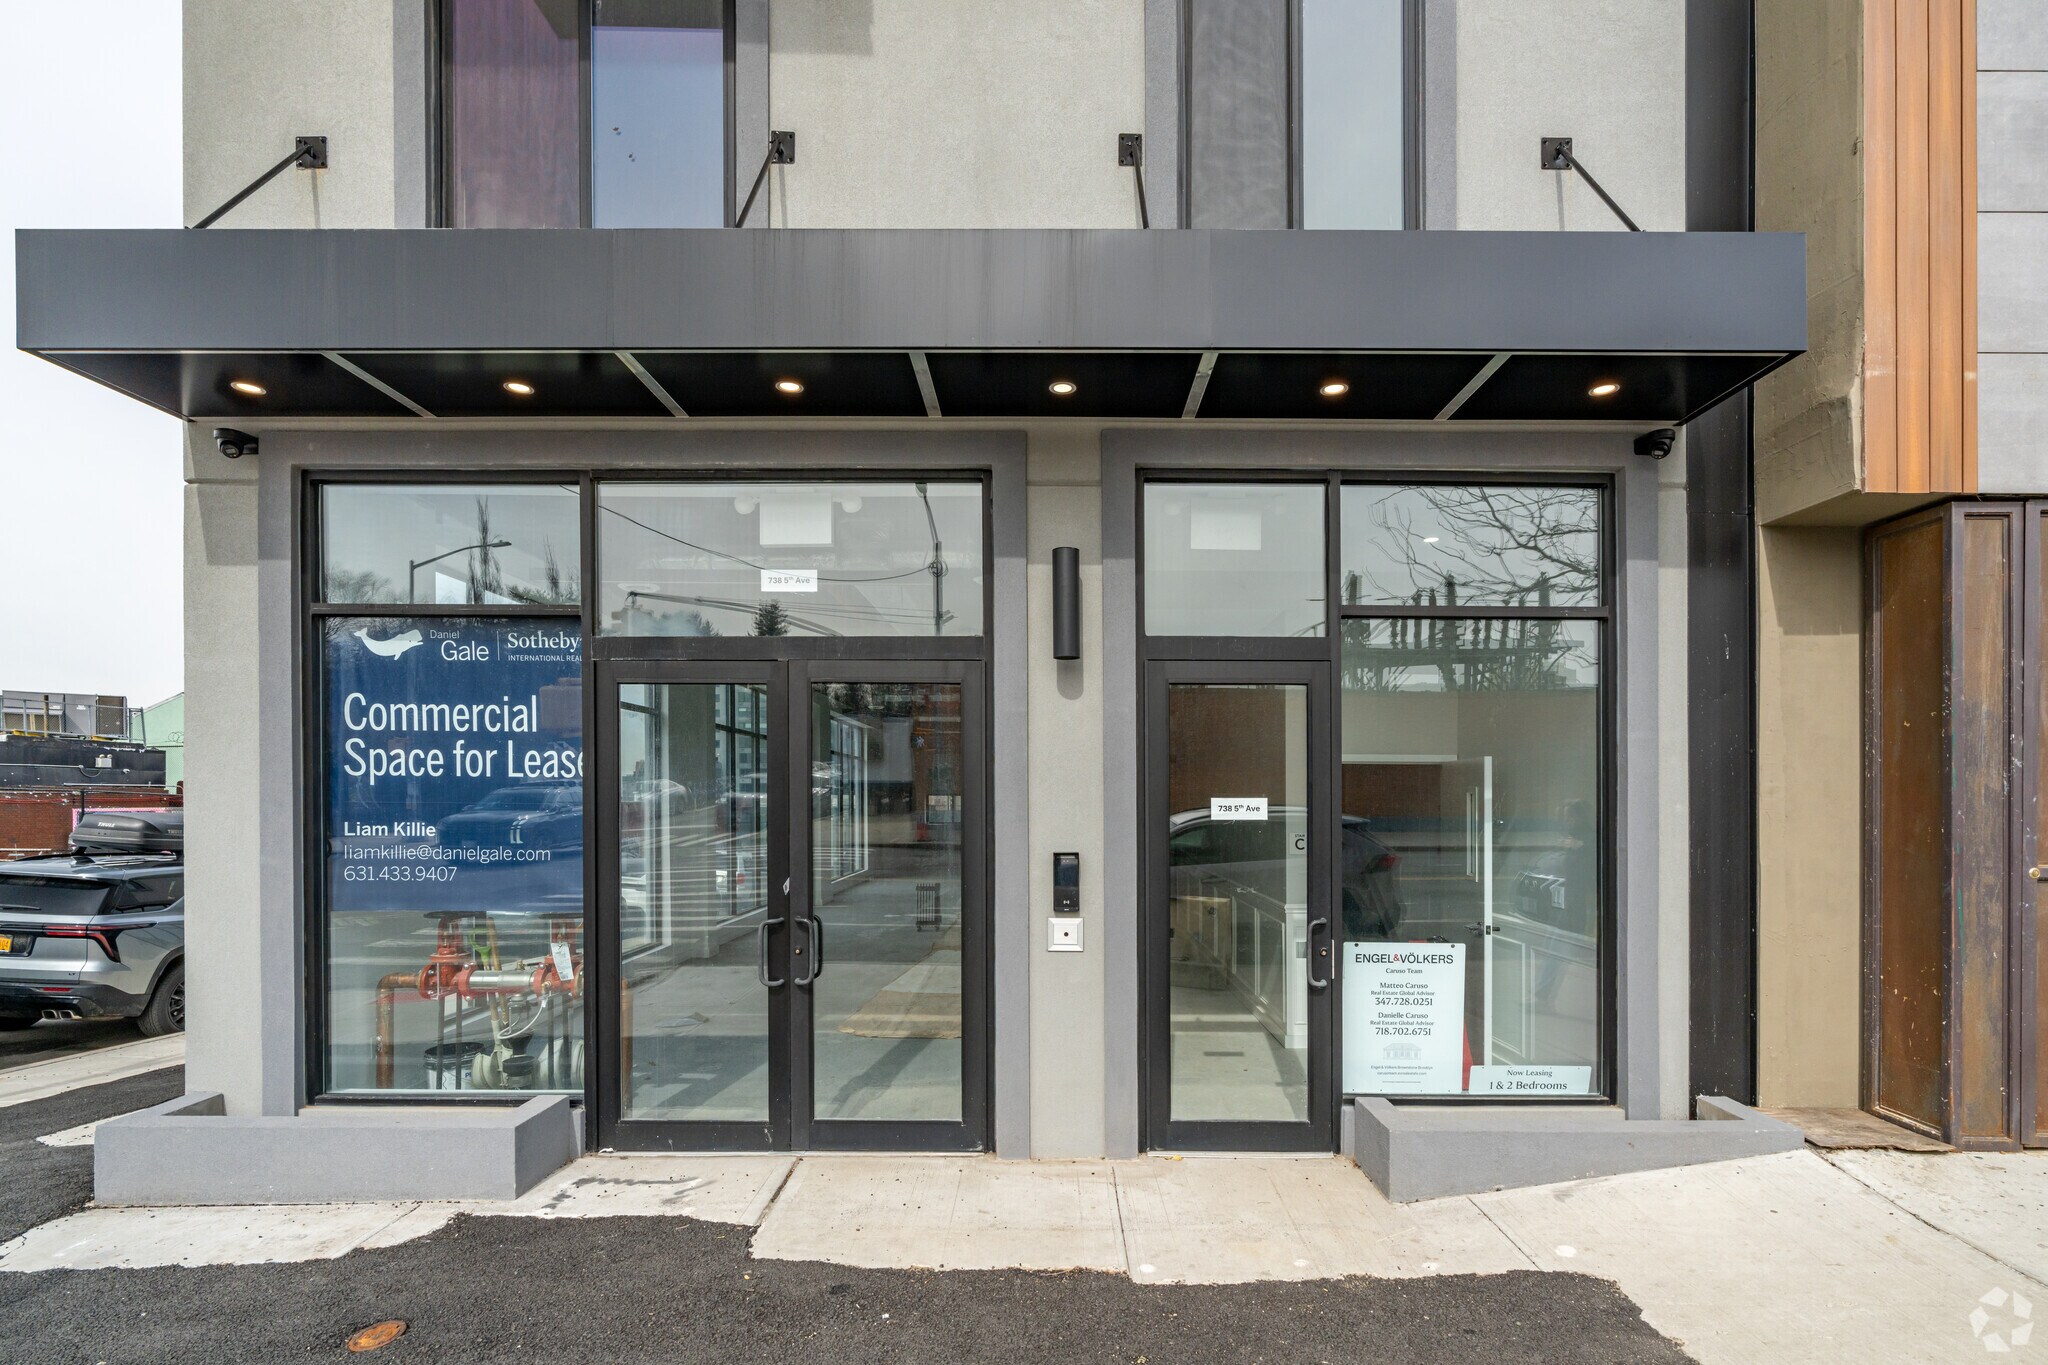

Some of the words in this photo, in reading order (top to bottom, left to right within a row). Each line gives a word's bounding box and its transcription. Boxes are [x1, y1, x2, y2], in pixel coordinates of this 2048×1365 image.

[429, 629, 460, 639] Daniel
[441, 640, 489, 661] Gale
[508, 654, 564, 662] INTERNATIONAL
[343, 692, 537, 733] Commercial
[343, 737, 444, 785] Space
[453, 740, 498, 777] for
[1234, 804, 1244, 812] 5th
[344, 821, 388, 837] Liam
[394, 821, 436, 837] Killie
[1295, 838, 1305, 850] C
[344, 844, 551, 864] liamkillie@danielgale.com
[344, 866, 458, 882] 631.433.9407
[1355, 952, 1454, 964] ENGEL&VÖLKERS
[1375, 997, 1433, 1006] 347.728.0251
[1375, 1027, 1431, 1036] 718.702.6751
[1525, 1069, 1553, 1077] Leasing
[1489, 1081, 1493, 1090] 1
[1496, 1081, 1504, 1090] &
[1507, 1081, 1513, 1090] 2
[1516, 1081, 1568, 1090] Bedrooms
